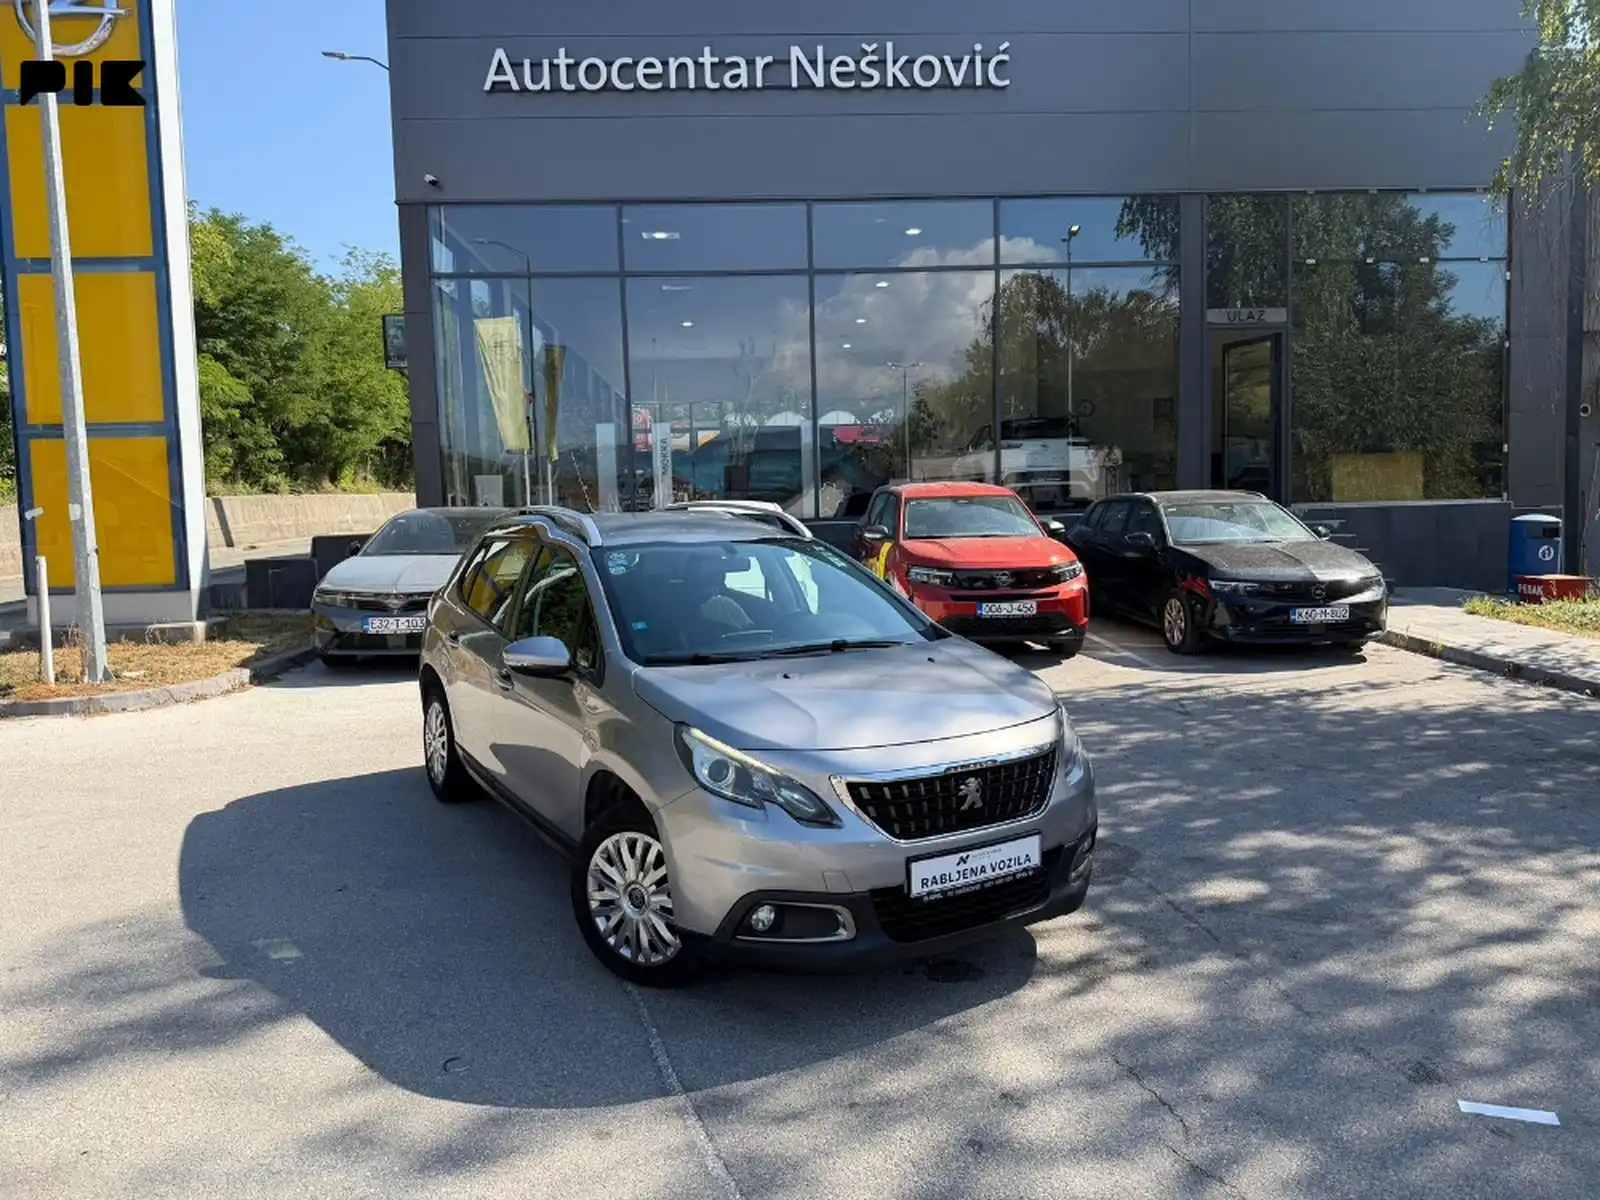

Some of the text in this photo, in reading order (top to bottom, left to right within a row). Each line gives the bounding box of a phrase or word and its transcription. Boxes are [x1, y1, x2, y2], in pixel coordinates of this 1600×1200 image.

[483, 41, 1010, 91] Autocentar Nešković
[1227, 310, 1266, 321] ULAZ
[660, 437, 670, 475] MOKKA
[920, 864, 987, 890] RABLJENA
[990, 853, 1032, 873] VOZILA
